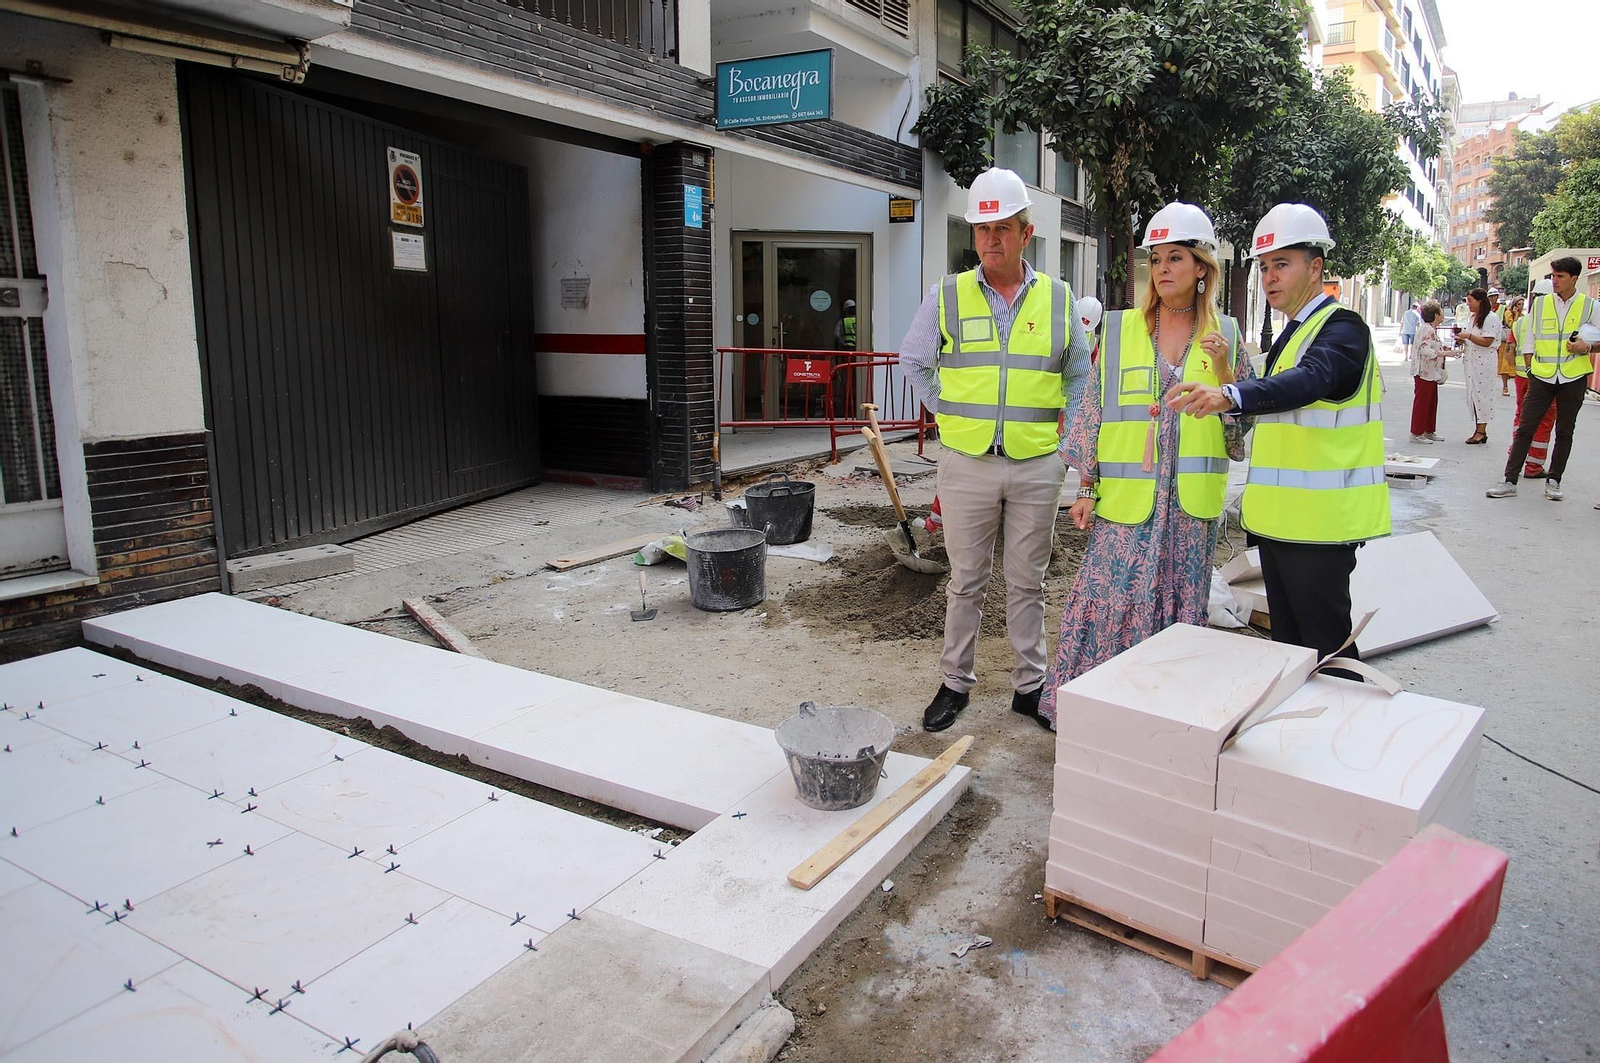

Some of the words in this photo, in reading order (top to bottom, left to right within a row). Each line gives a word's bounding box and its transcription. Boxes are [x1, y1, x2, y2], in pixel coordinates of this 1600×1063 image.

[728, 67, 820, 110] Bocanegra
[739, 95, 757, 103] ASESOR
[757, 92, 789, 101] INMOBILIARIO
